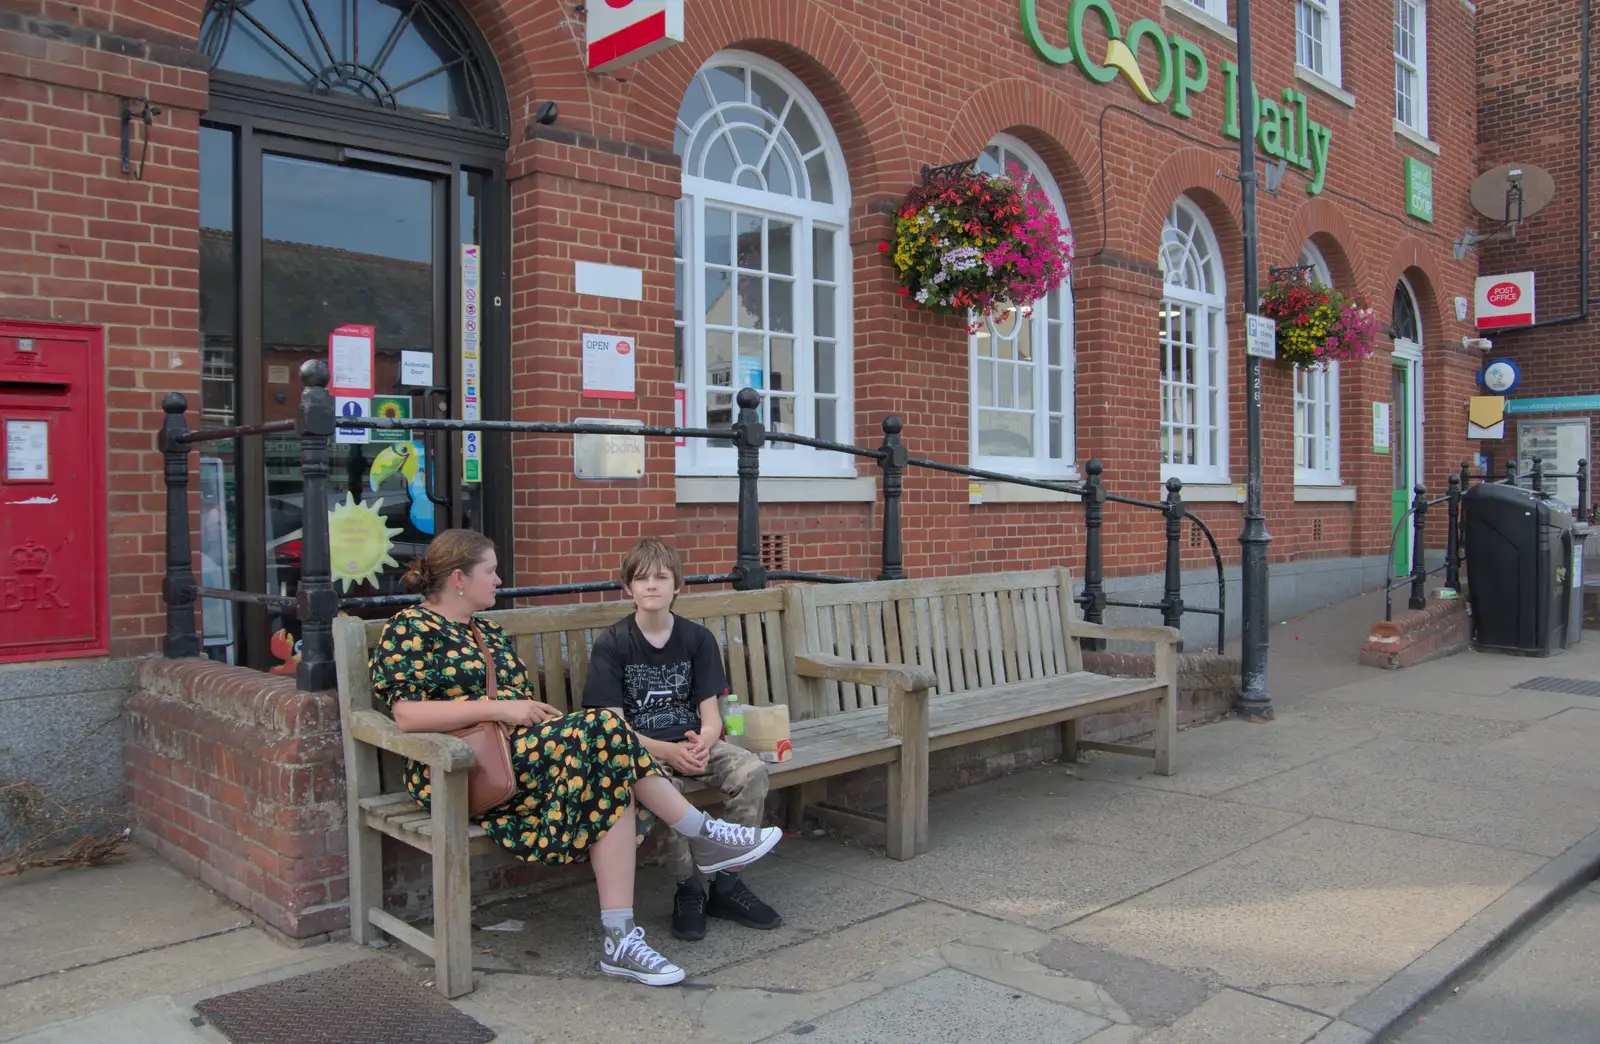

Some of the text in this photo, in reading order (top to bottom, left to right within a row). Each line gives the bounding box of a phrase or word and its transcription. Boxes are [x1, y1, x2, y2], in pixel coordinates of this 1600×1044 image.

[1220, 60, 1332, 195] Daily
[1494, 286, 1515, 296] POST
[1489, 293, 1518, 303] OFFICE
[586, 340, 609, 350] OPEN
[403, 361, 430, 369] Automatic
[410, 367, 425, 375] Door
